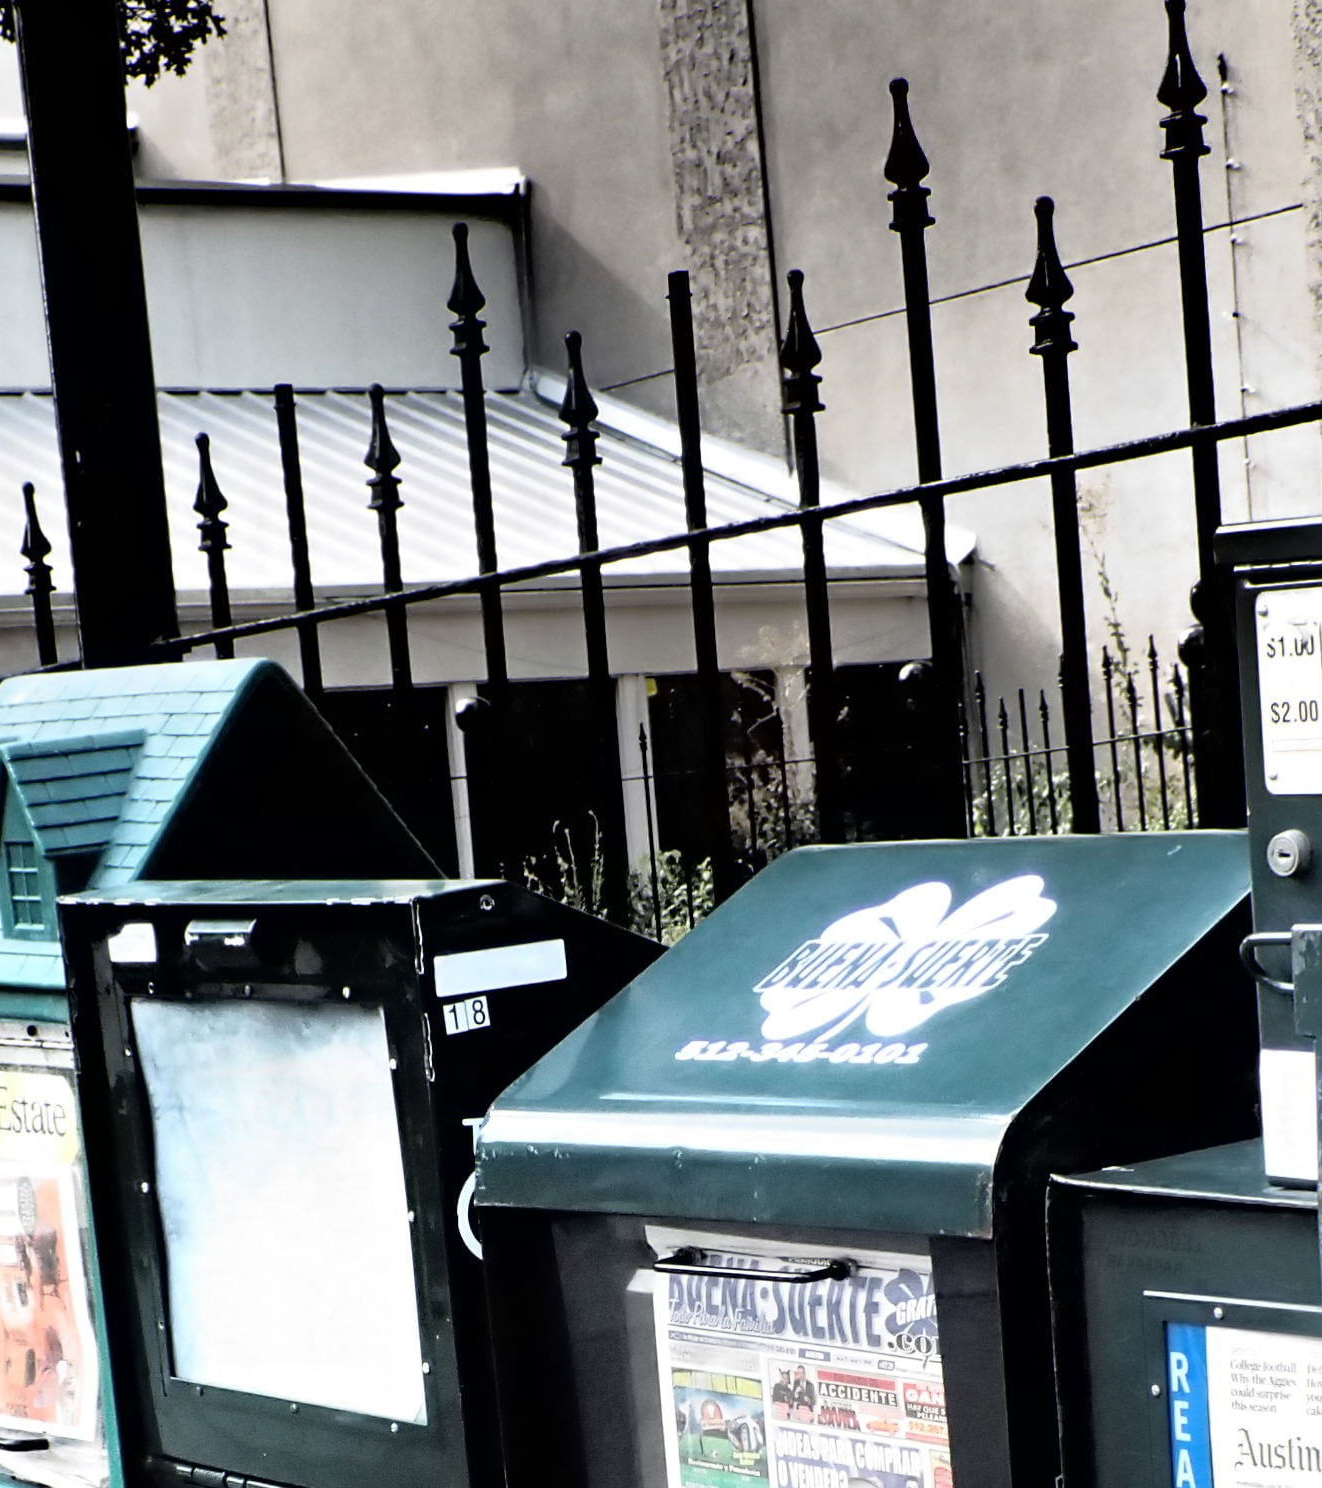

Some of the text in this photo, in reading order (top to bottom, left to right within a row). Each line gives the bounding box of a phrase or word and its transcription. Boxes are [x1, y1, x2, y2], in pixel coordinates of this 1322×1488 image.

[1270, 700, 1319, 724] $2.00
[1230, 1360, 1261, 1373] College
[1231, 1373, 1250, 1387] Why
[1252, 1374, 1267, 1385] the
[819, 1383, 897, 1407] ACCIDENTE
[1231, 1388, 1291, 1402] could surprise
[1231, 1400, 1247, 1411] this
[1234, 1427, 1322, 1473] Austin
